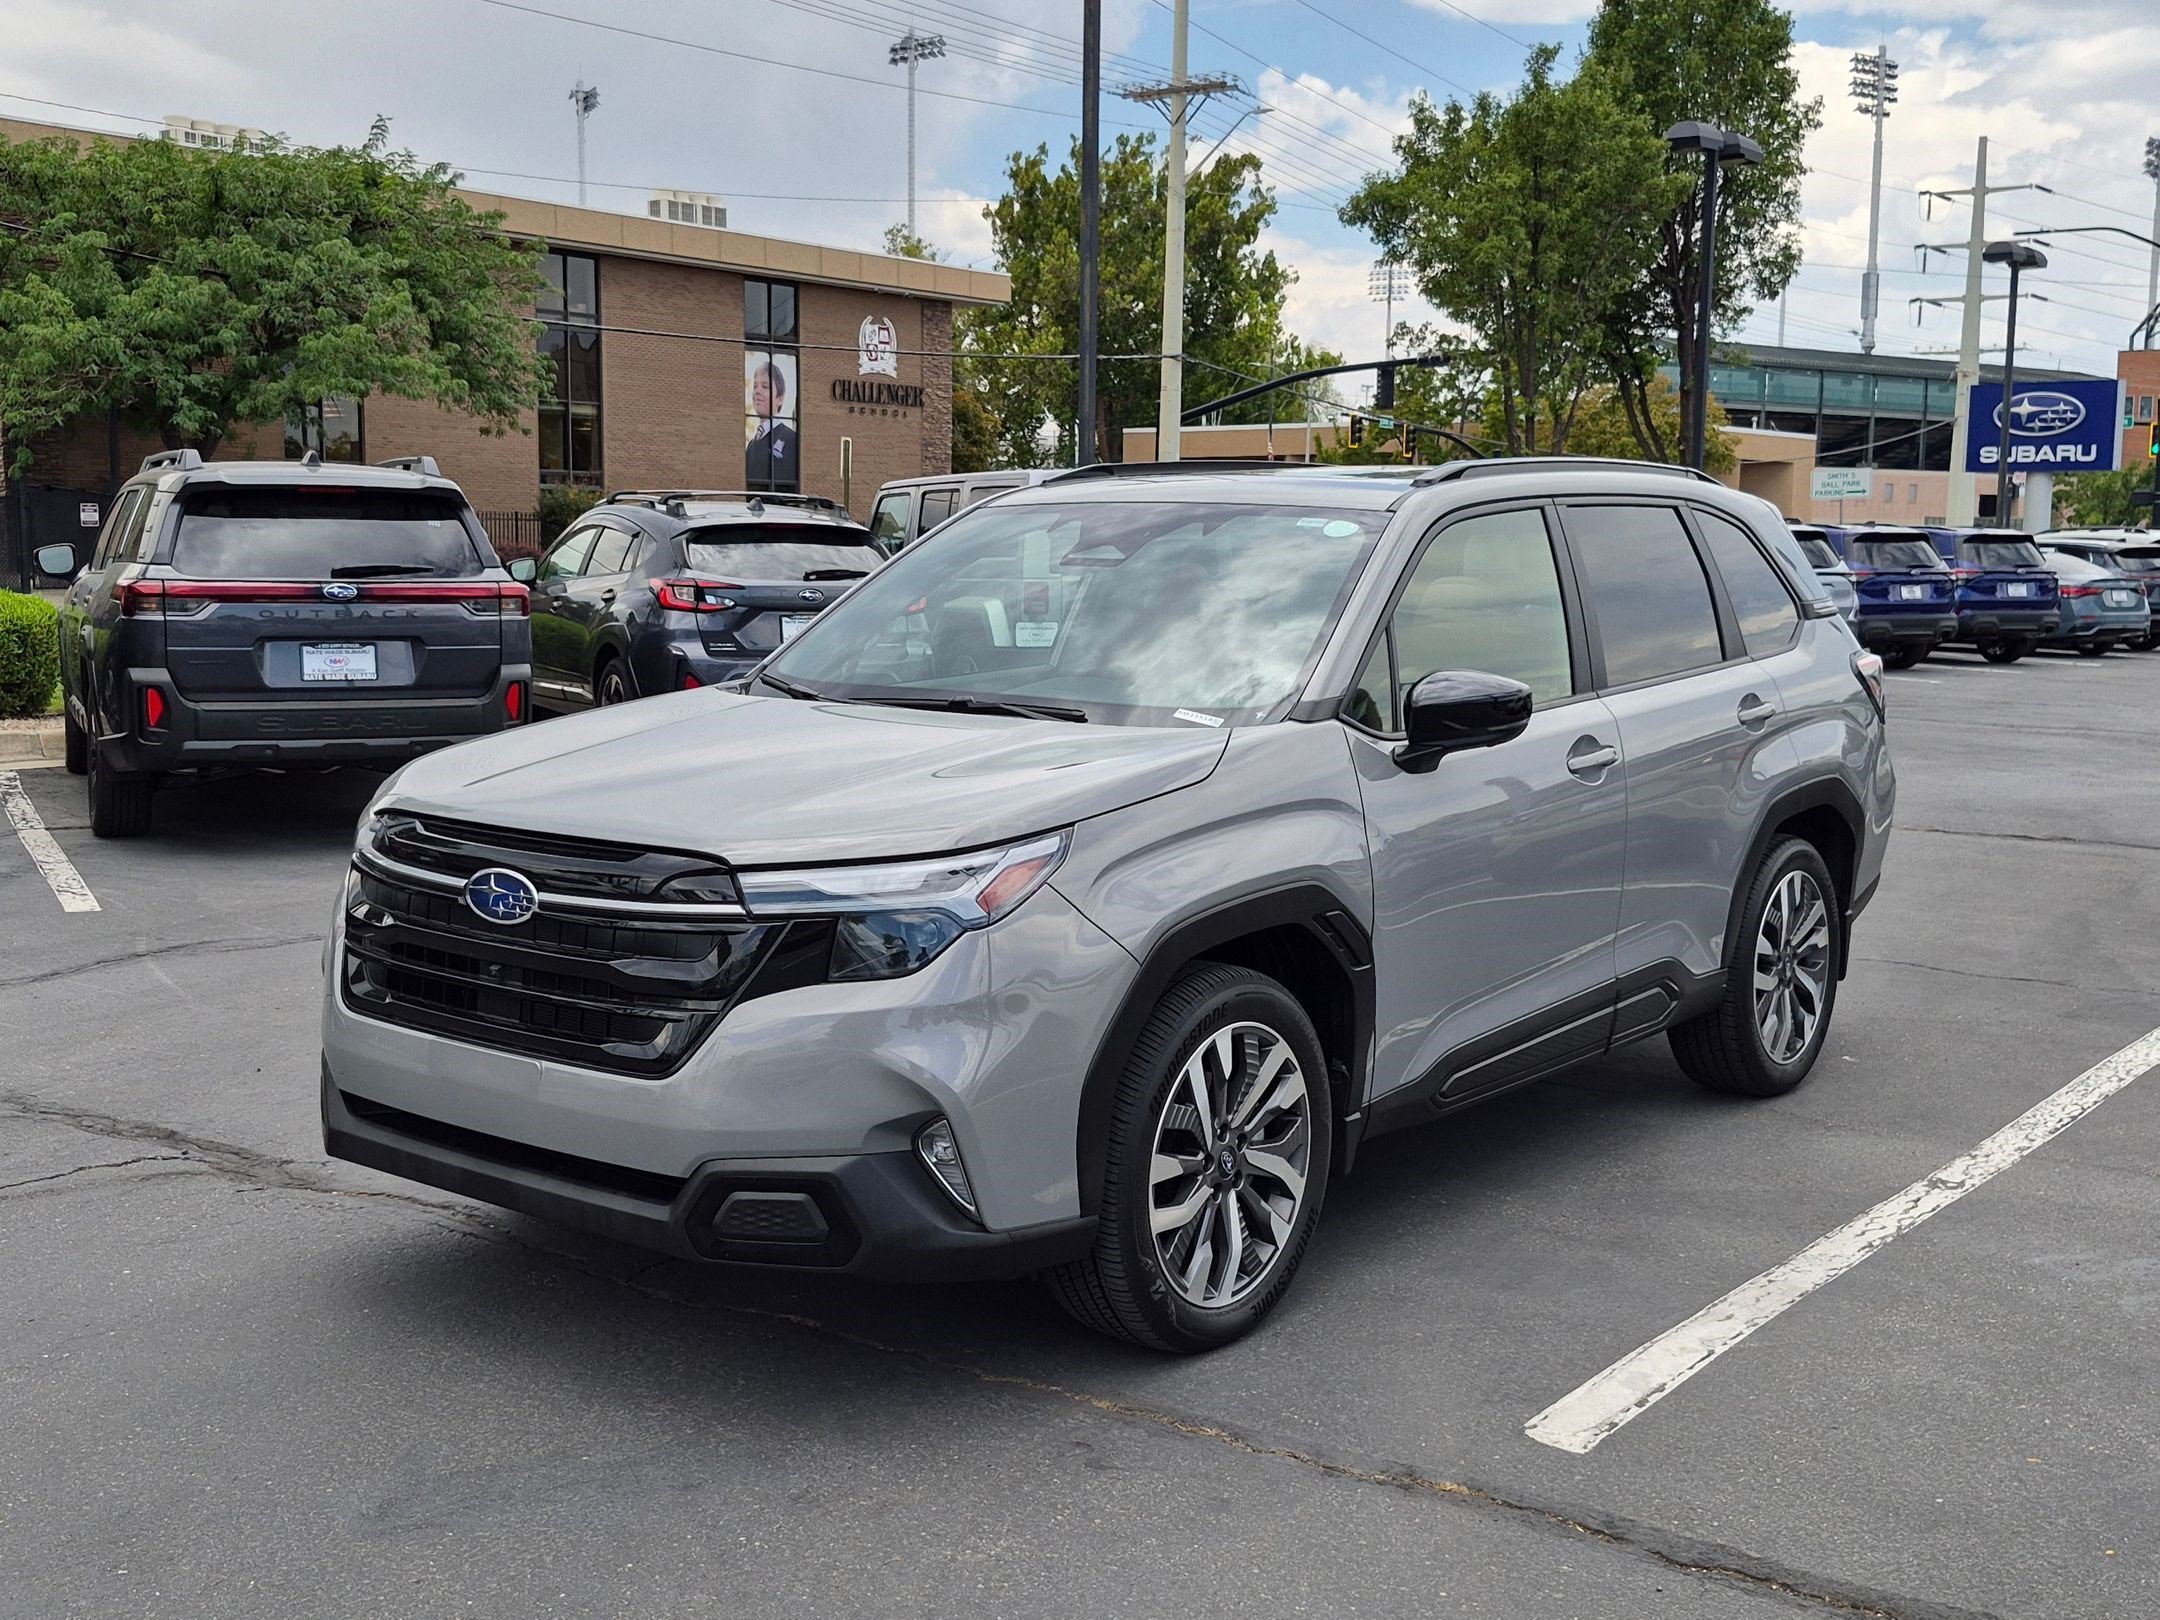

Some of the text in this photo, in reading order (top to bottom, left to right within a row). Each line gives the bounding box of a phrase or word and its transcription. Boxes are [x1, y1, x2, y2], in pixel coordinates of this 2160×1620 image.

[832, 379, 925, 407] CHALLENGER
[848, 406, 908, 418] SCHOOL
[1979, 444, 2098, 464] SUBARU
[259, 609, 420, 619] OUTBACK
[1150, 1002, 1228, 1117] BRIDGESTONE
[1250, 1205, 1318, 1321] BRIDGESTONE
